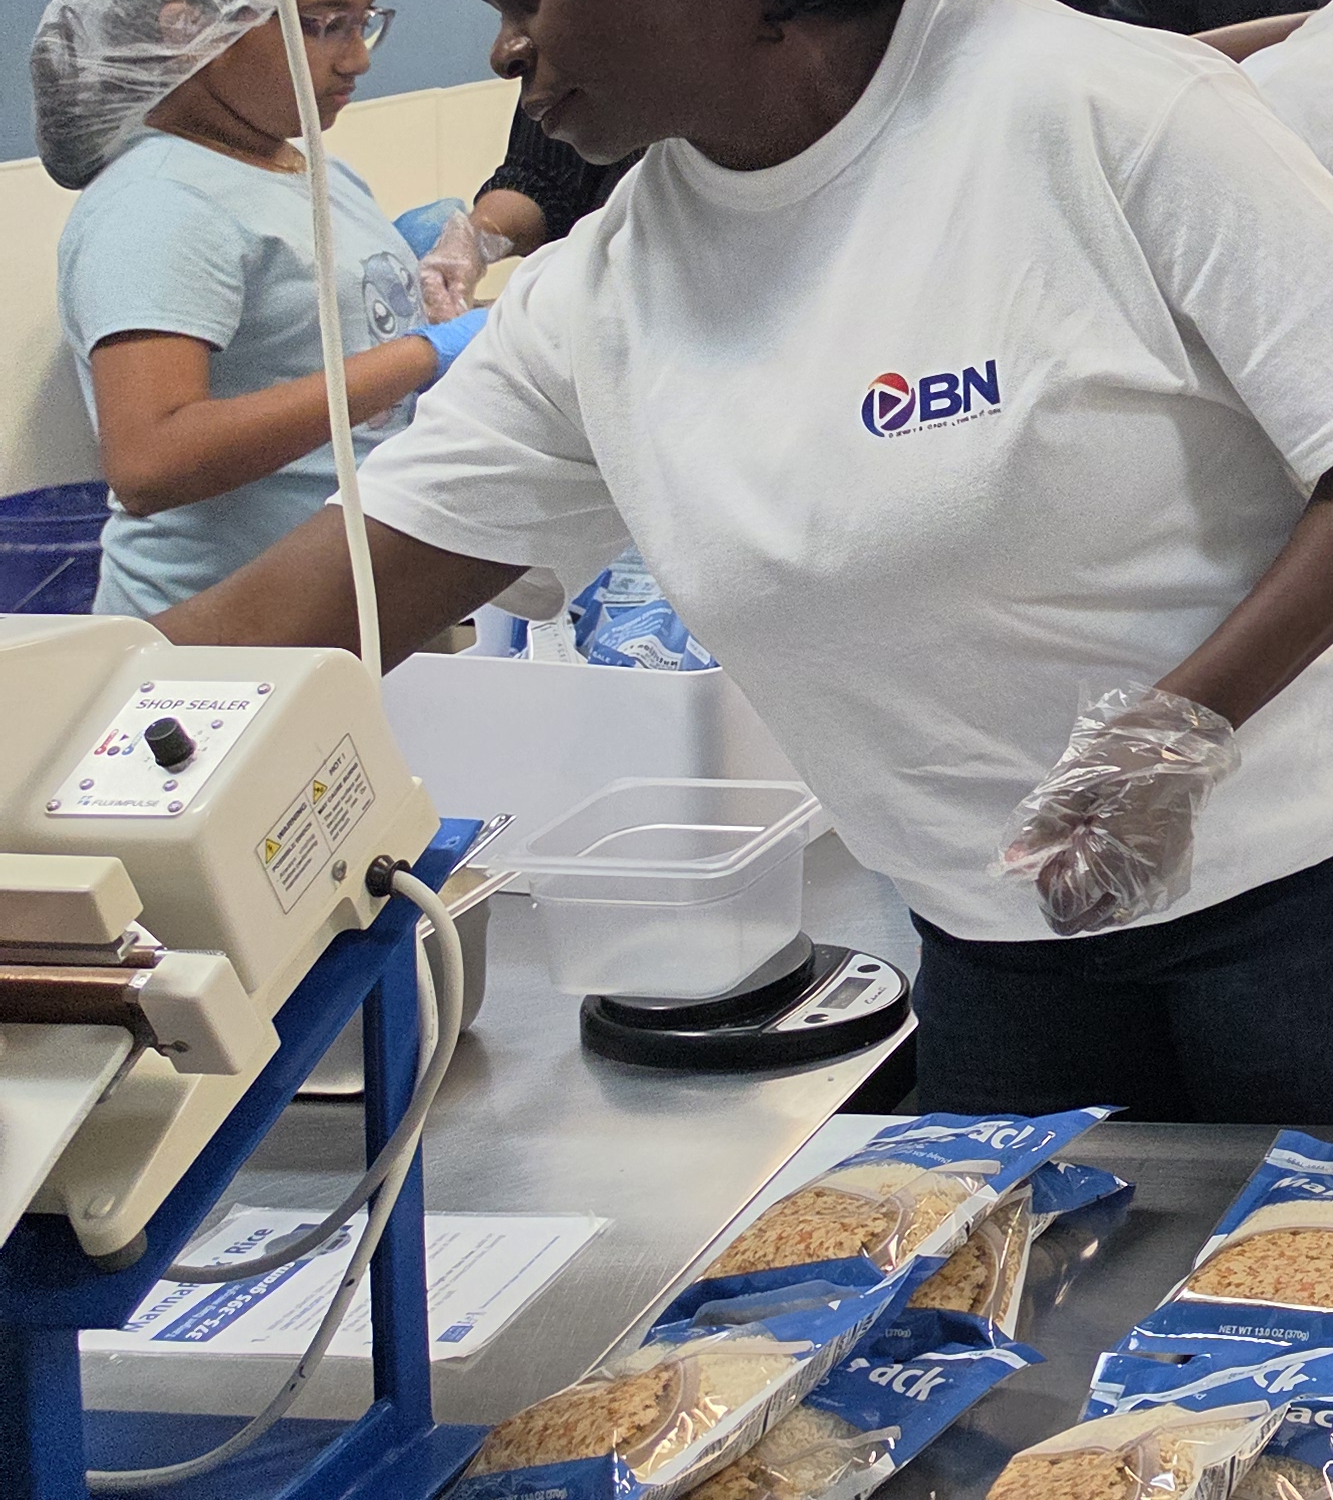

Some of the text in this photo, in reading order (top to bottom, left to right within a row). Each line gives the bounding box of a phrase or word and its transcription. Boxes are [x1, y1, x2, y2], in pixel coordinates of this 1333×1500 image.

[136, 699, 250, 710] SHOP SEALER
[328, 756, 342, 776] HOT
[277, 800, 307, 841] WARNING
[224, 1227, 274, 1255] Rice
[1219, 1324, 1310, 1342] NET WT 13.0 OZ (370g)
